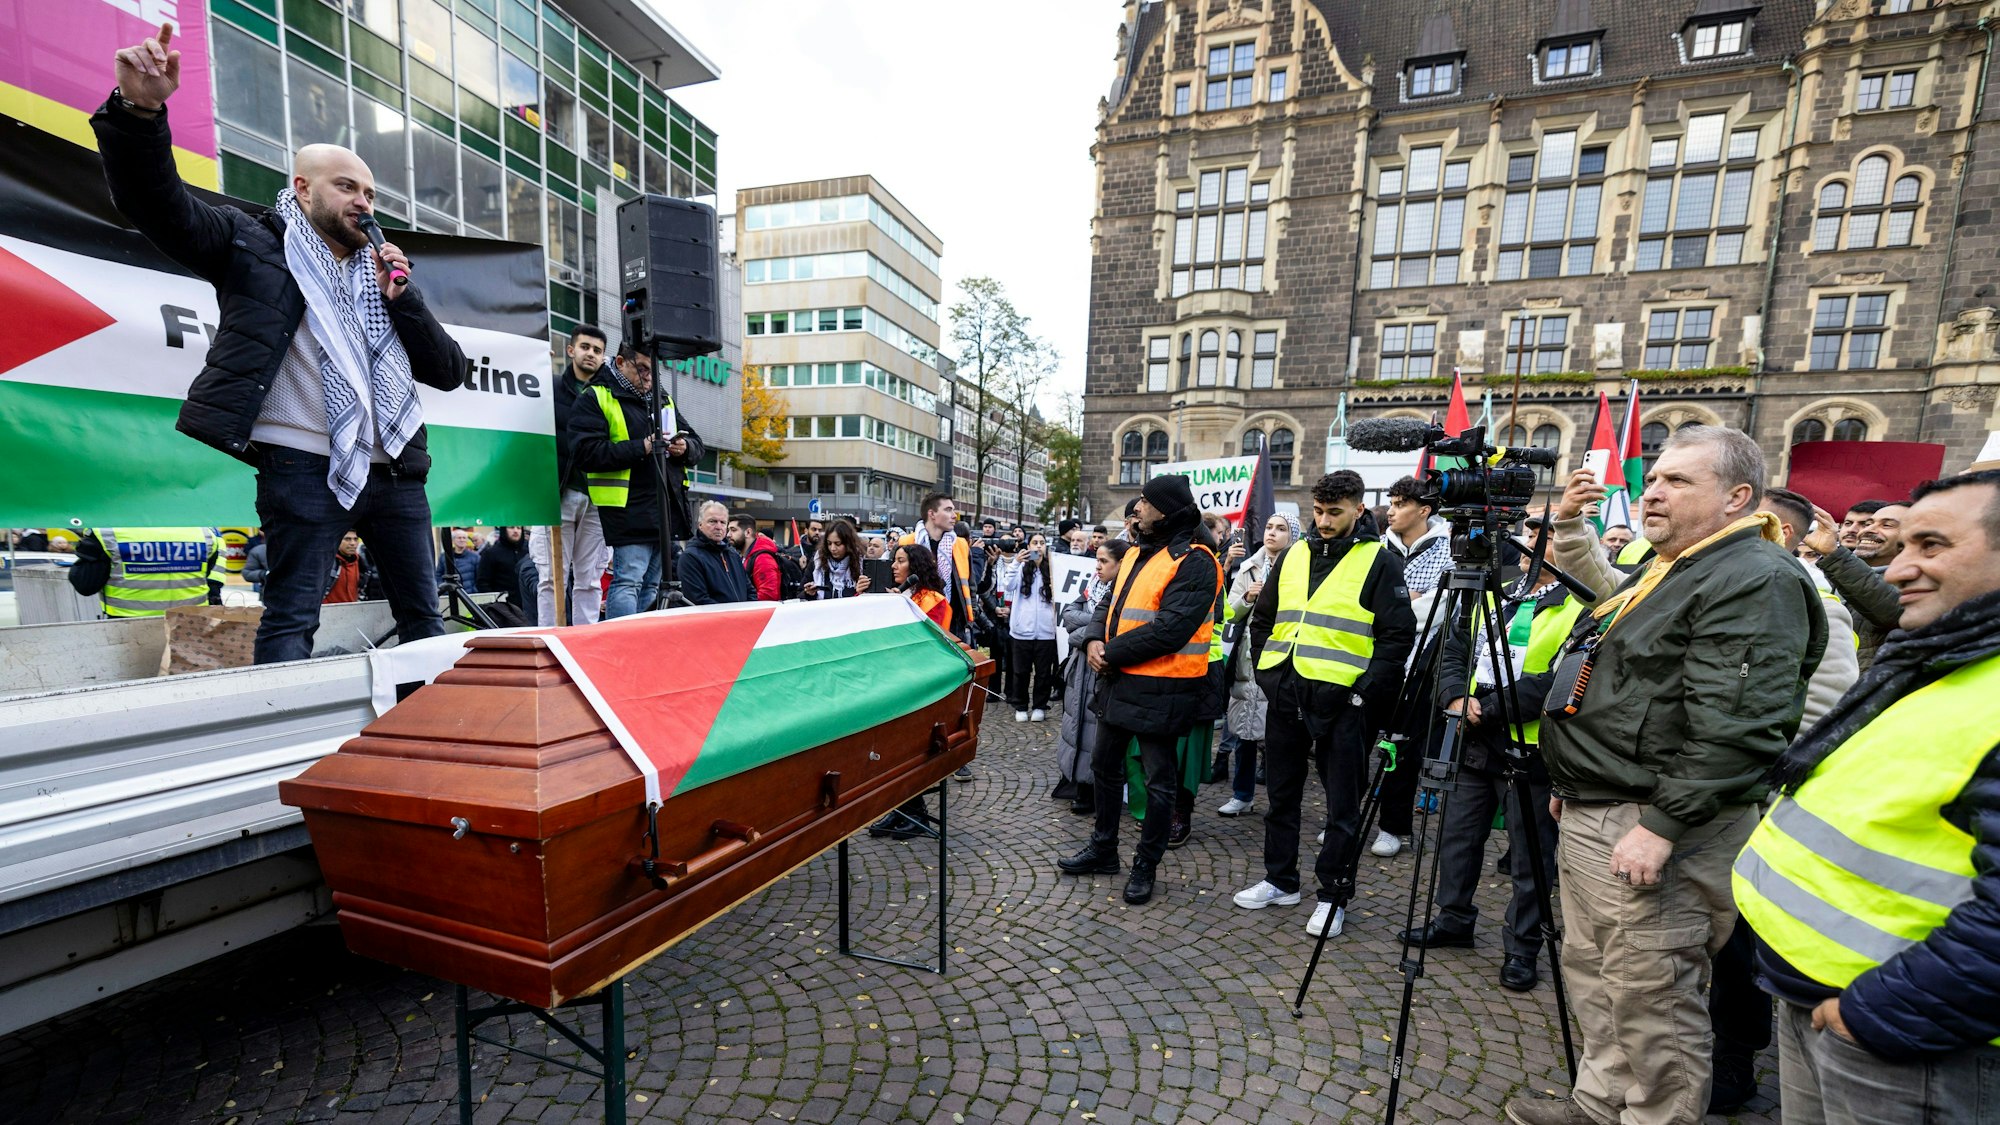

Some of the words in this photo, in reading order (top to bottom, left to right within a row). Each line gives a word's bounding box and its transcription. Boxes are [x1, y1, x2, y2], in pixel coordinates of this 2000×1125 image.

[463, 356, 541, 398] tine
[1200, 489, 1243, 510] CRY!
[129, 542, 201, 561] POLIZEI
